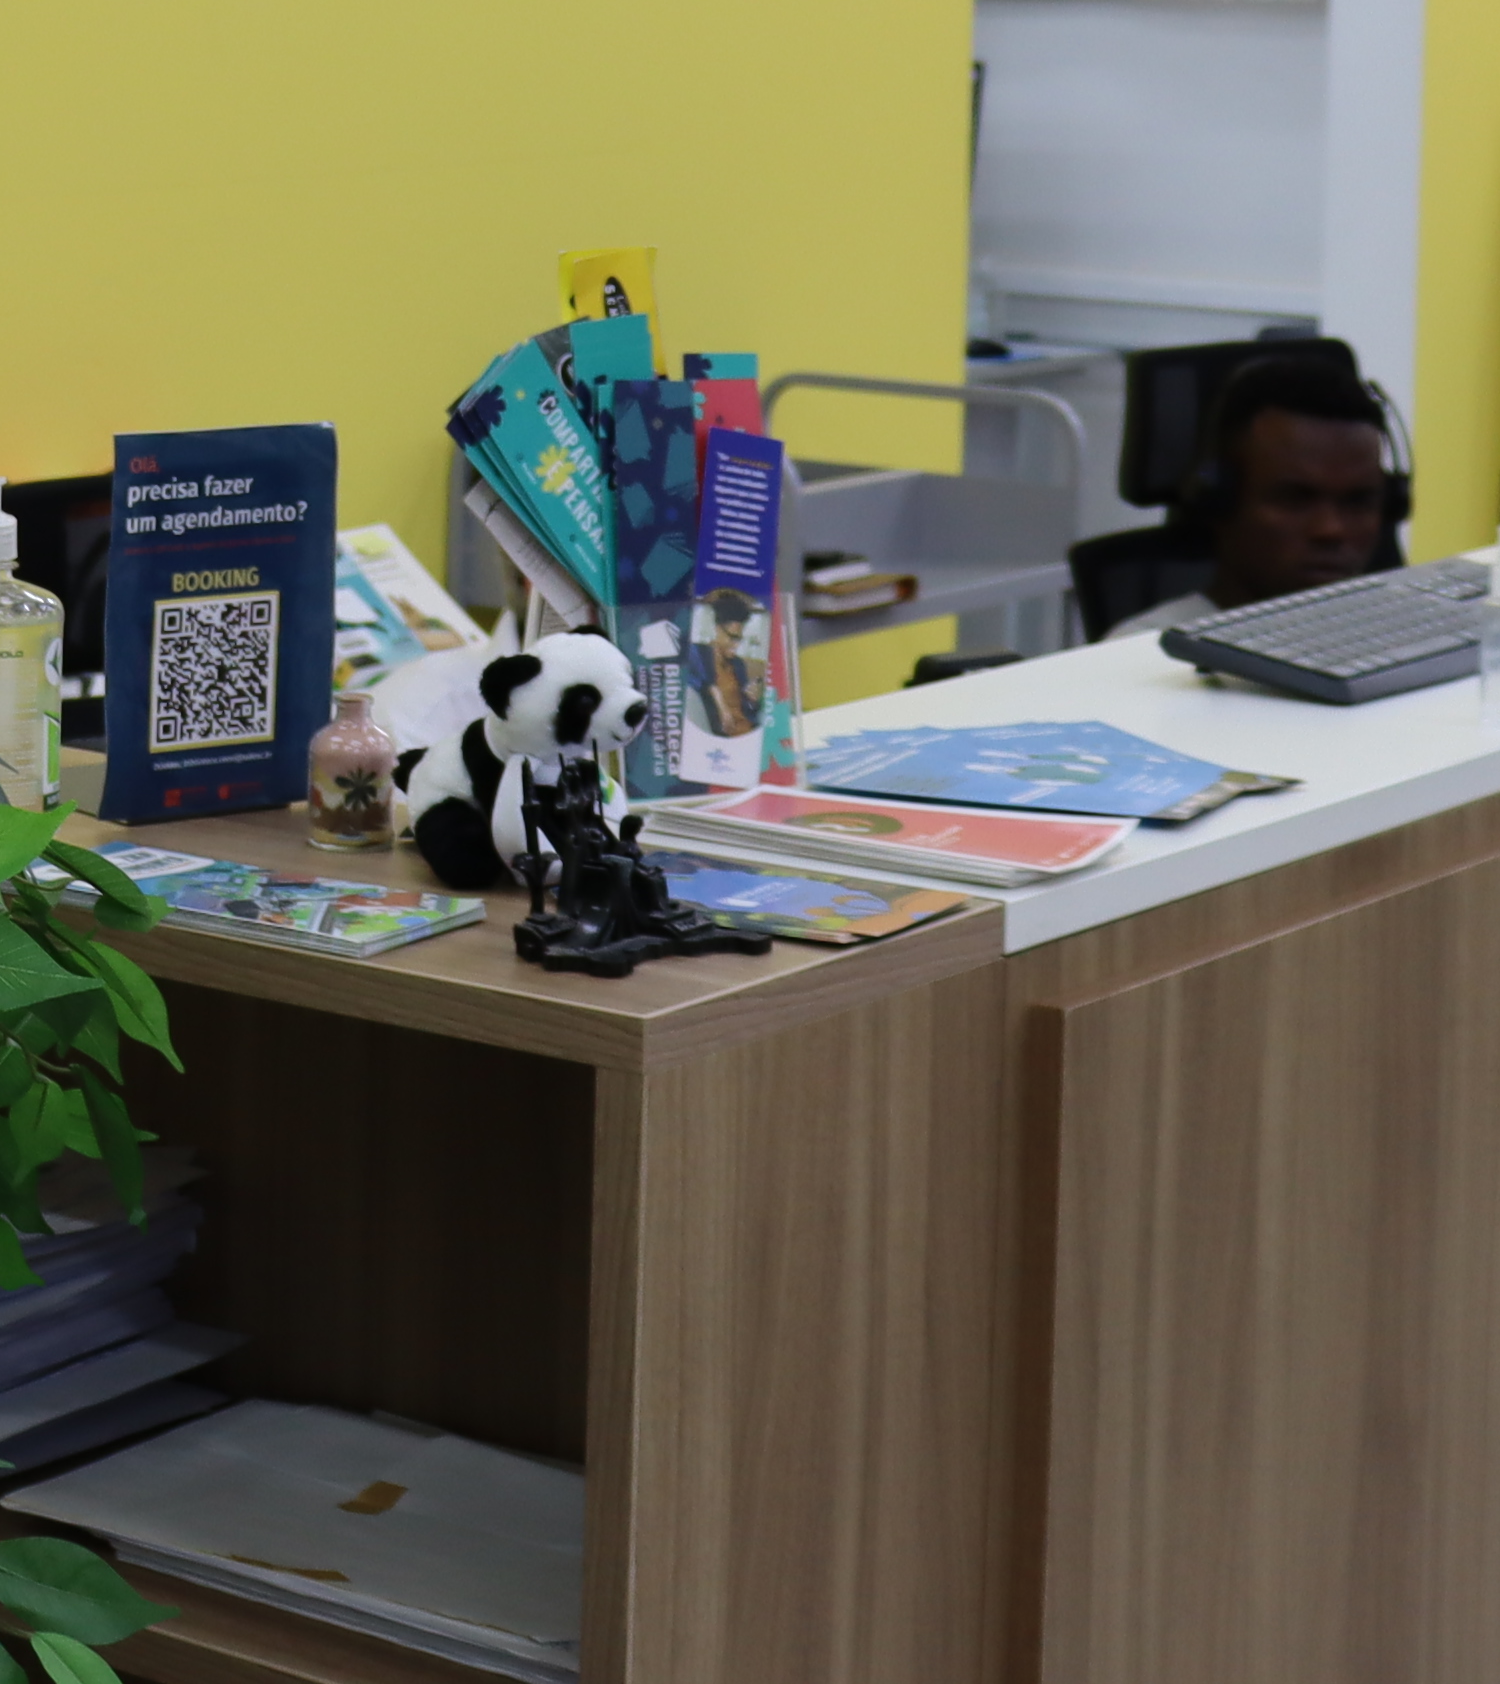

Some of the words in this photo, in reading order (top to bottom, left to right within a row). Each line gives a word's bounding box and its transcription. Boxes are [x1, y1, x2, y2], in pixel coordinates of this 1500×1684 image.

[126, 477, 199, 508] precisa
[204, 475, 254, 498] fazer
[126, 515, 157, 535] um
[161, 500, 308, 536] agendamento?
[172, 567, 260, 592] BOOKING
[664, 663, 683, 776] Biblioteca
